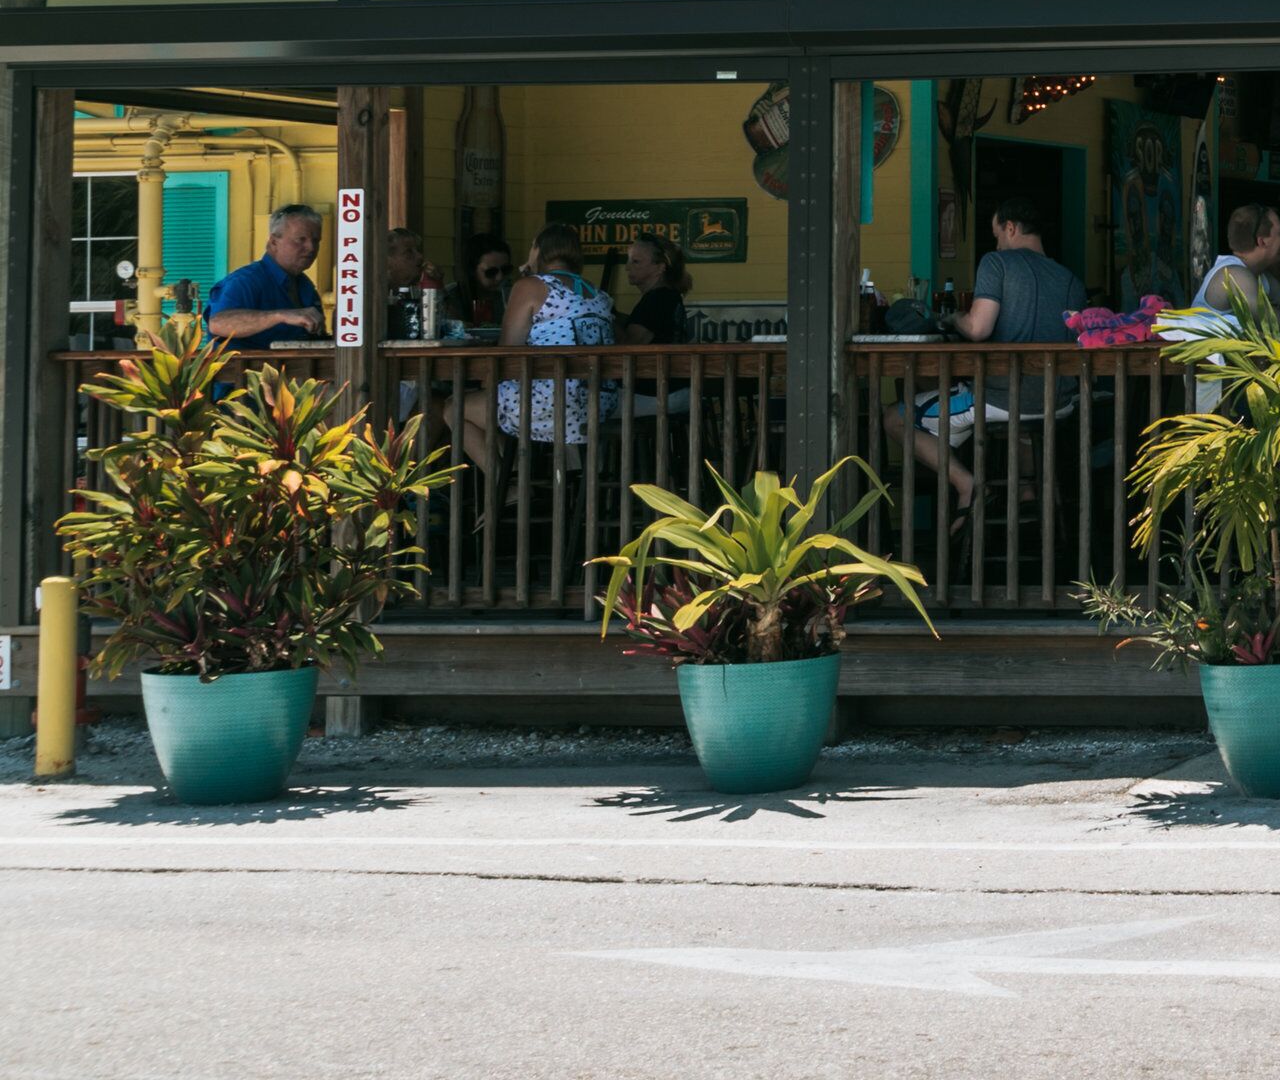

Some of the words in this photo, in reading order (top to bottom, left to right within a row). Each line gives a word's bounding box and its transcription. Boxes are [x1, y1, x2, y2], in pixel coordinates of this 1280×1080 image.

[342, 193, 360, 222] NO
[584, 206, 650, 223] Genuine
[570, 224, 607, 242] HN
[340, 237, 359, 343] PARKING
